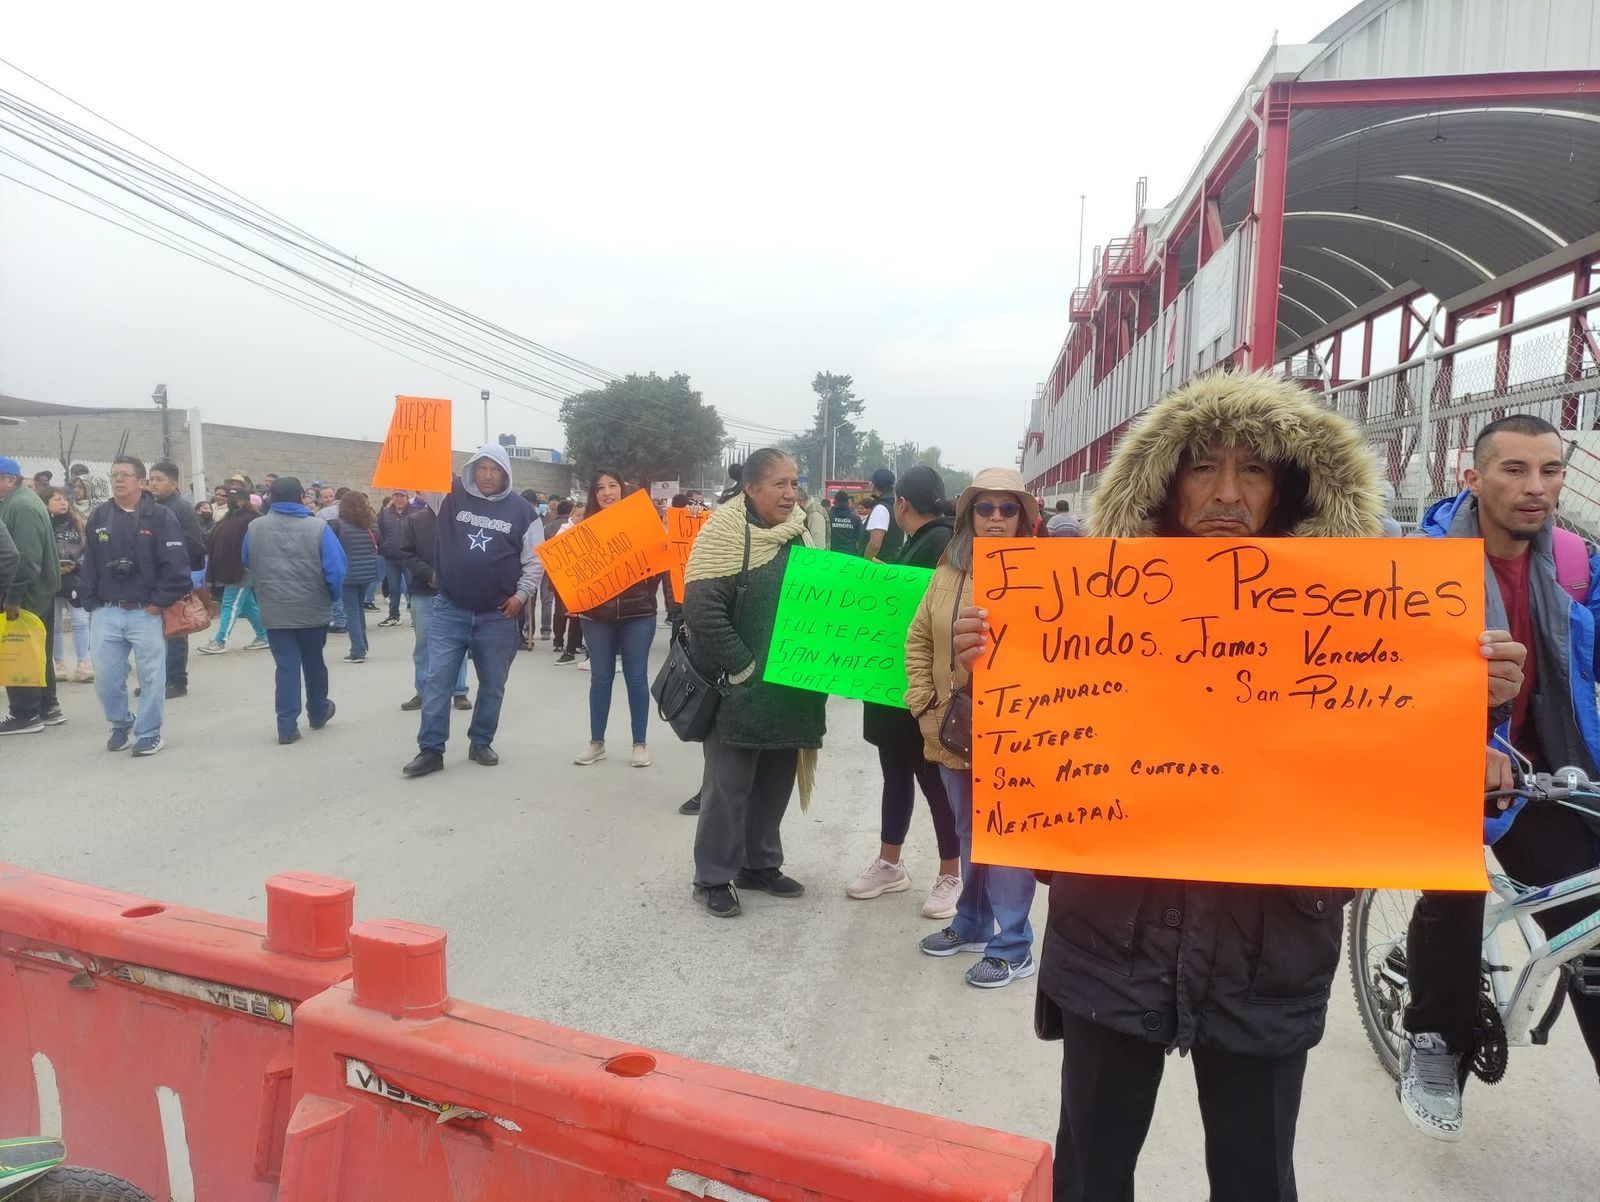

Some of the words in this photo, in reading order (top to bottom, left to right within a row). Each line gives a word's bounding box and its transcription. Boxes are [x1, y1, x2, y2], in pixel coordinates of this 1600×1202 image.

[986, 539, 1174, 623] Ejidos
[1207, 545, 1468, 620] Presentes
[770, 638, 821, 665] SAN
[824, 651, 896, 671] MATEO
[1176, 615, 1268, 664] Jamas
[777, 666, 901, 704] CUATEPEC
[1236, 669, 1279, 705] San
